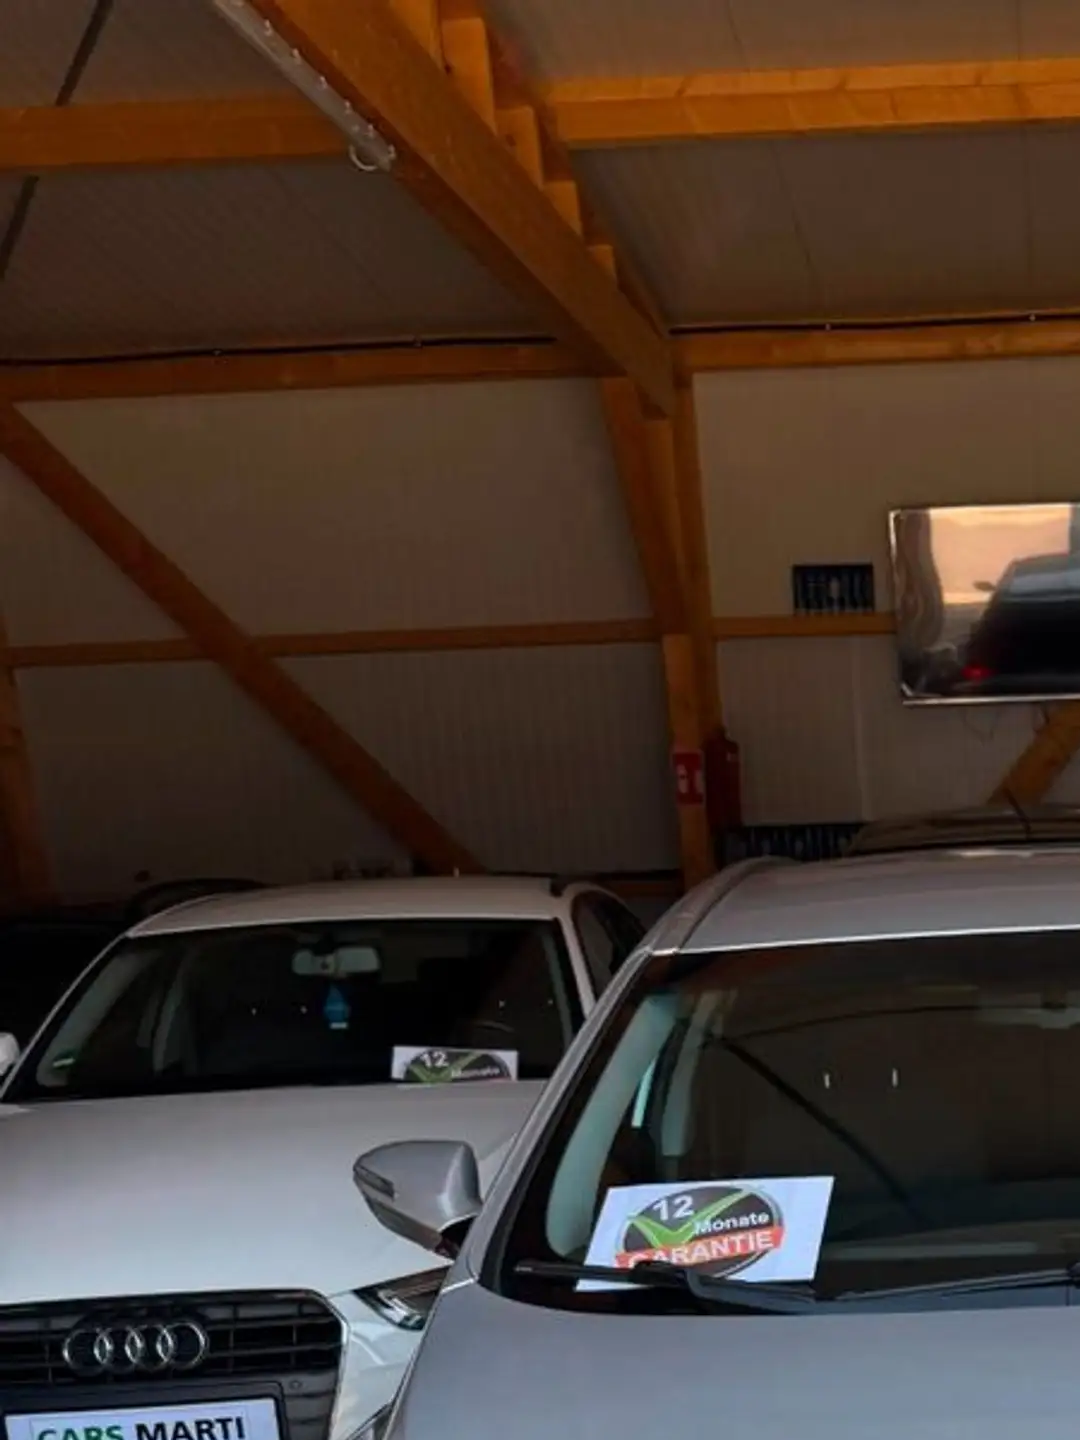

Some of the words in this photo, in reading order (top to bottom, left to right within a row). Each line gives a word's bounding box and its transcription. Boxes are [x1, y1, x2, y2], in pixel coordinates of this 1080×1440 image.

[421, 1051, 449, 1068] 12
[653, 1195, 695, 1221] 12
[695, 1212, 770, 1235] Monate
